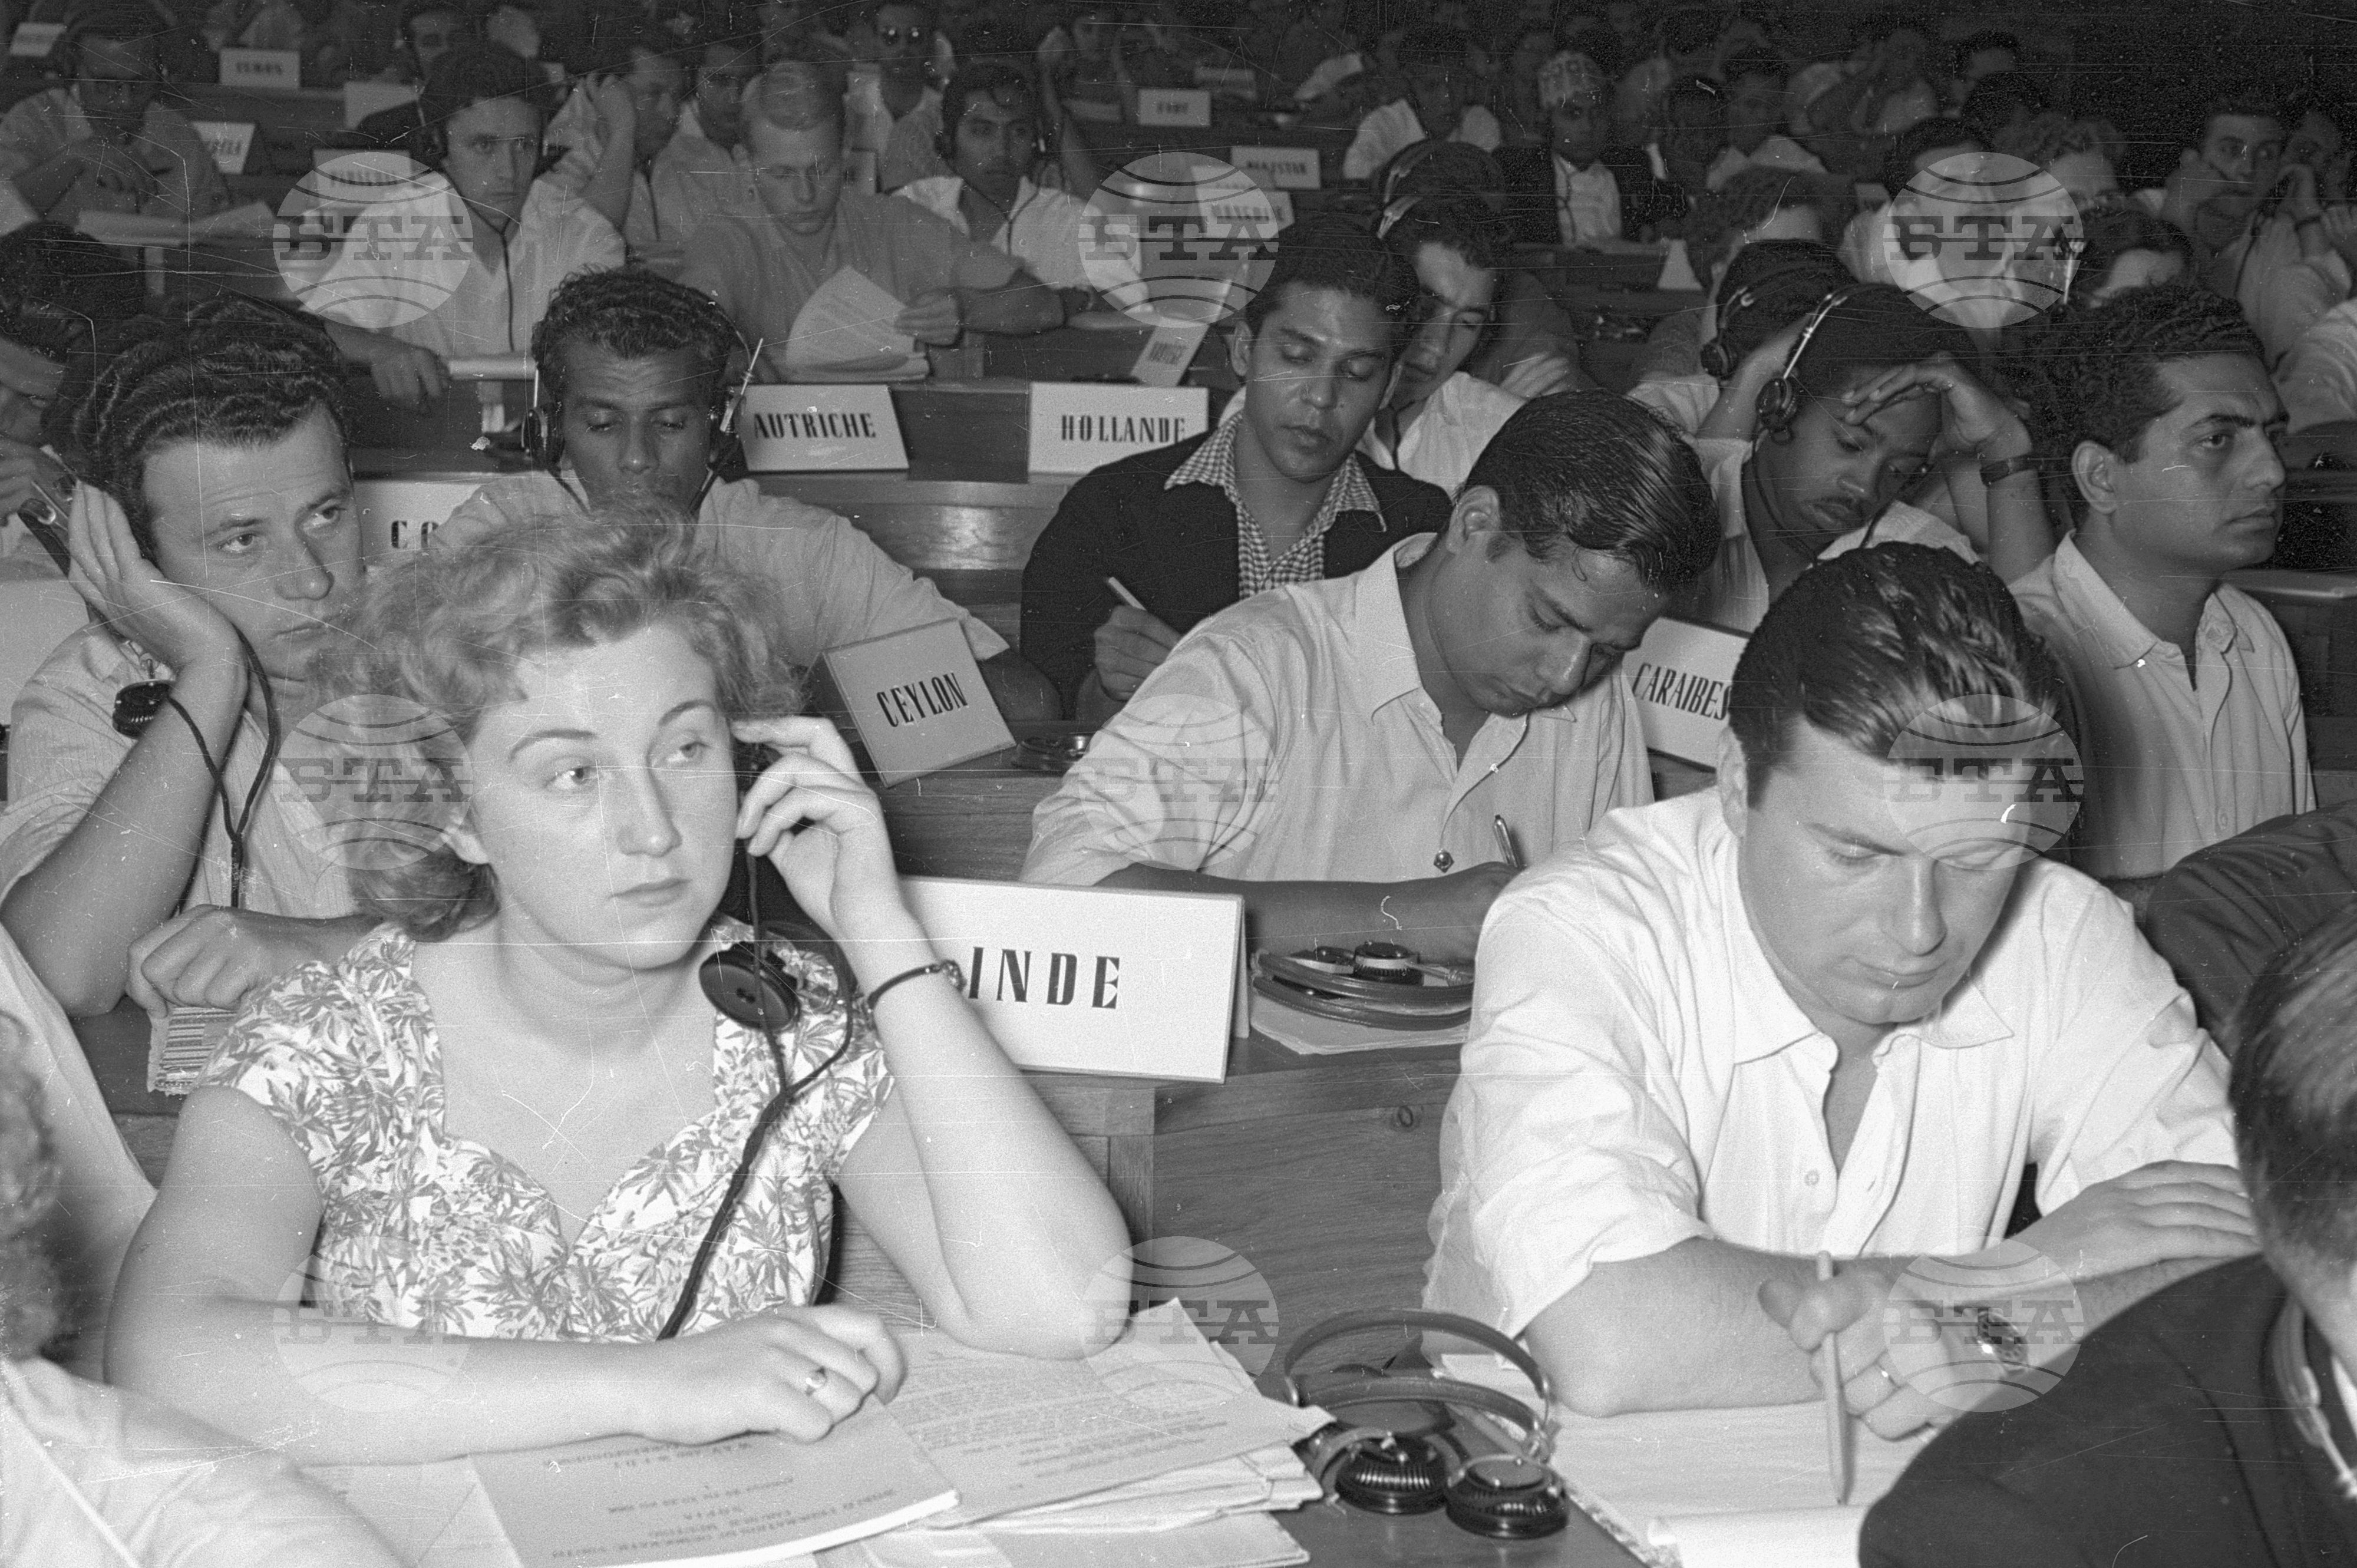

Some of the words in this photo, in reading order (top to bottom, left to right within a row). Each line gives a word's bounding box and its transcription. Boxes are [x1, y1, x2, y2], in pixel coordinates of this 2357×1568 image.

[753, 413, 876, 438] AUTRICHE
[1062, 415, 1184, 443] HOLLANDE
[877, 672, 968, 727] CEYLON
[1632, 662, 1732, 720] CARAIBES
[968, 946, 1120, 1009] INDE
